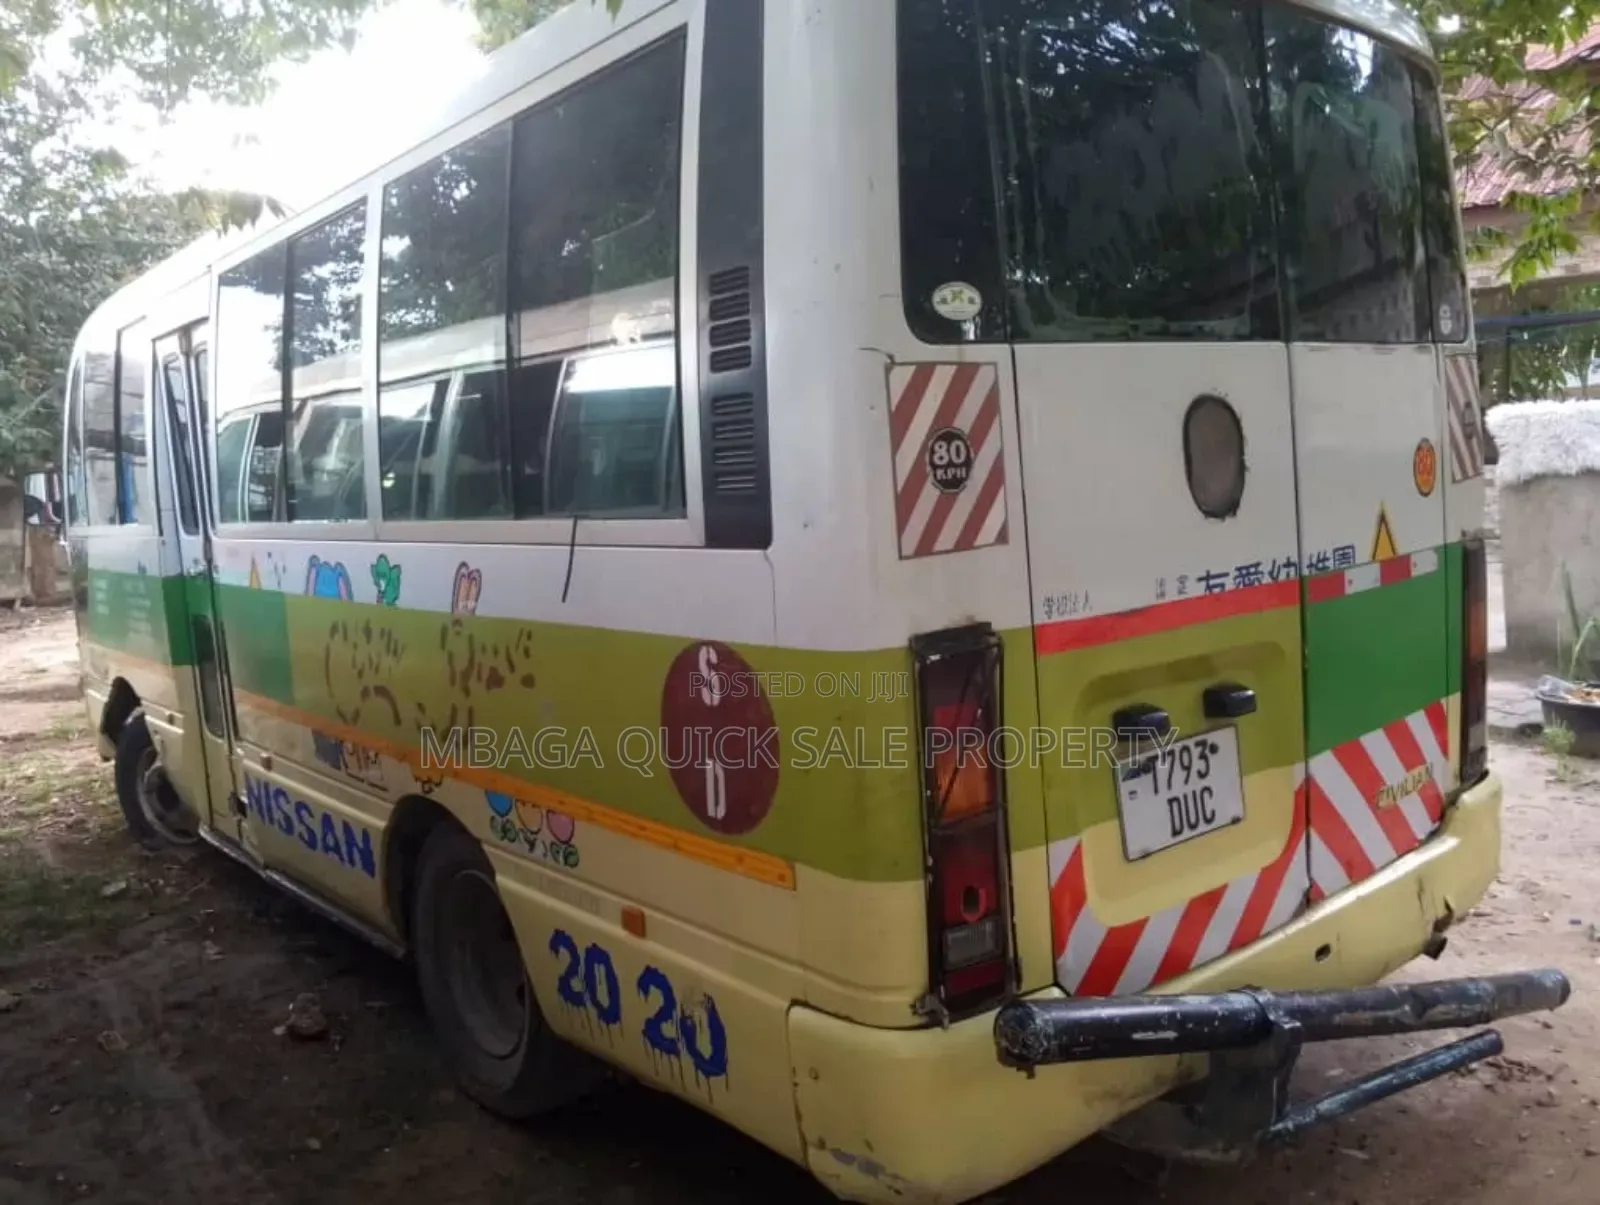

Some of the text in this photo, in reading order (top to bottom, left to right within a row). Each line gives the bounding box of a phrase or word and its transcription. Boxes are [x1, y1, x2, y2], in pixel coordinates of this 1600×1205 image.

[932, 439, 967, 466] 80
[936, 466, 967, 480] KPH
[698, 644, 721, 707] S
[705, 757, 728, 820] D
[1147, 738, 1211, 796] T793
[244, 773, 376, 880] NISSAN
[1167, 785, 1216, 838] DUC
